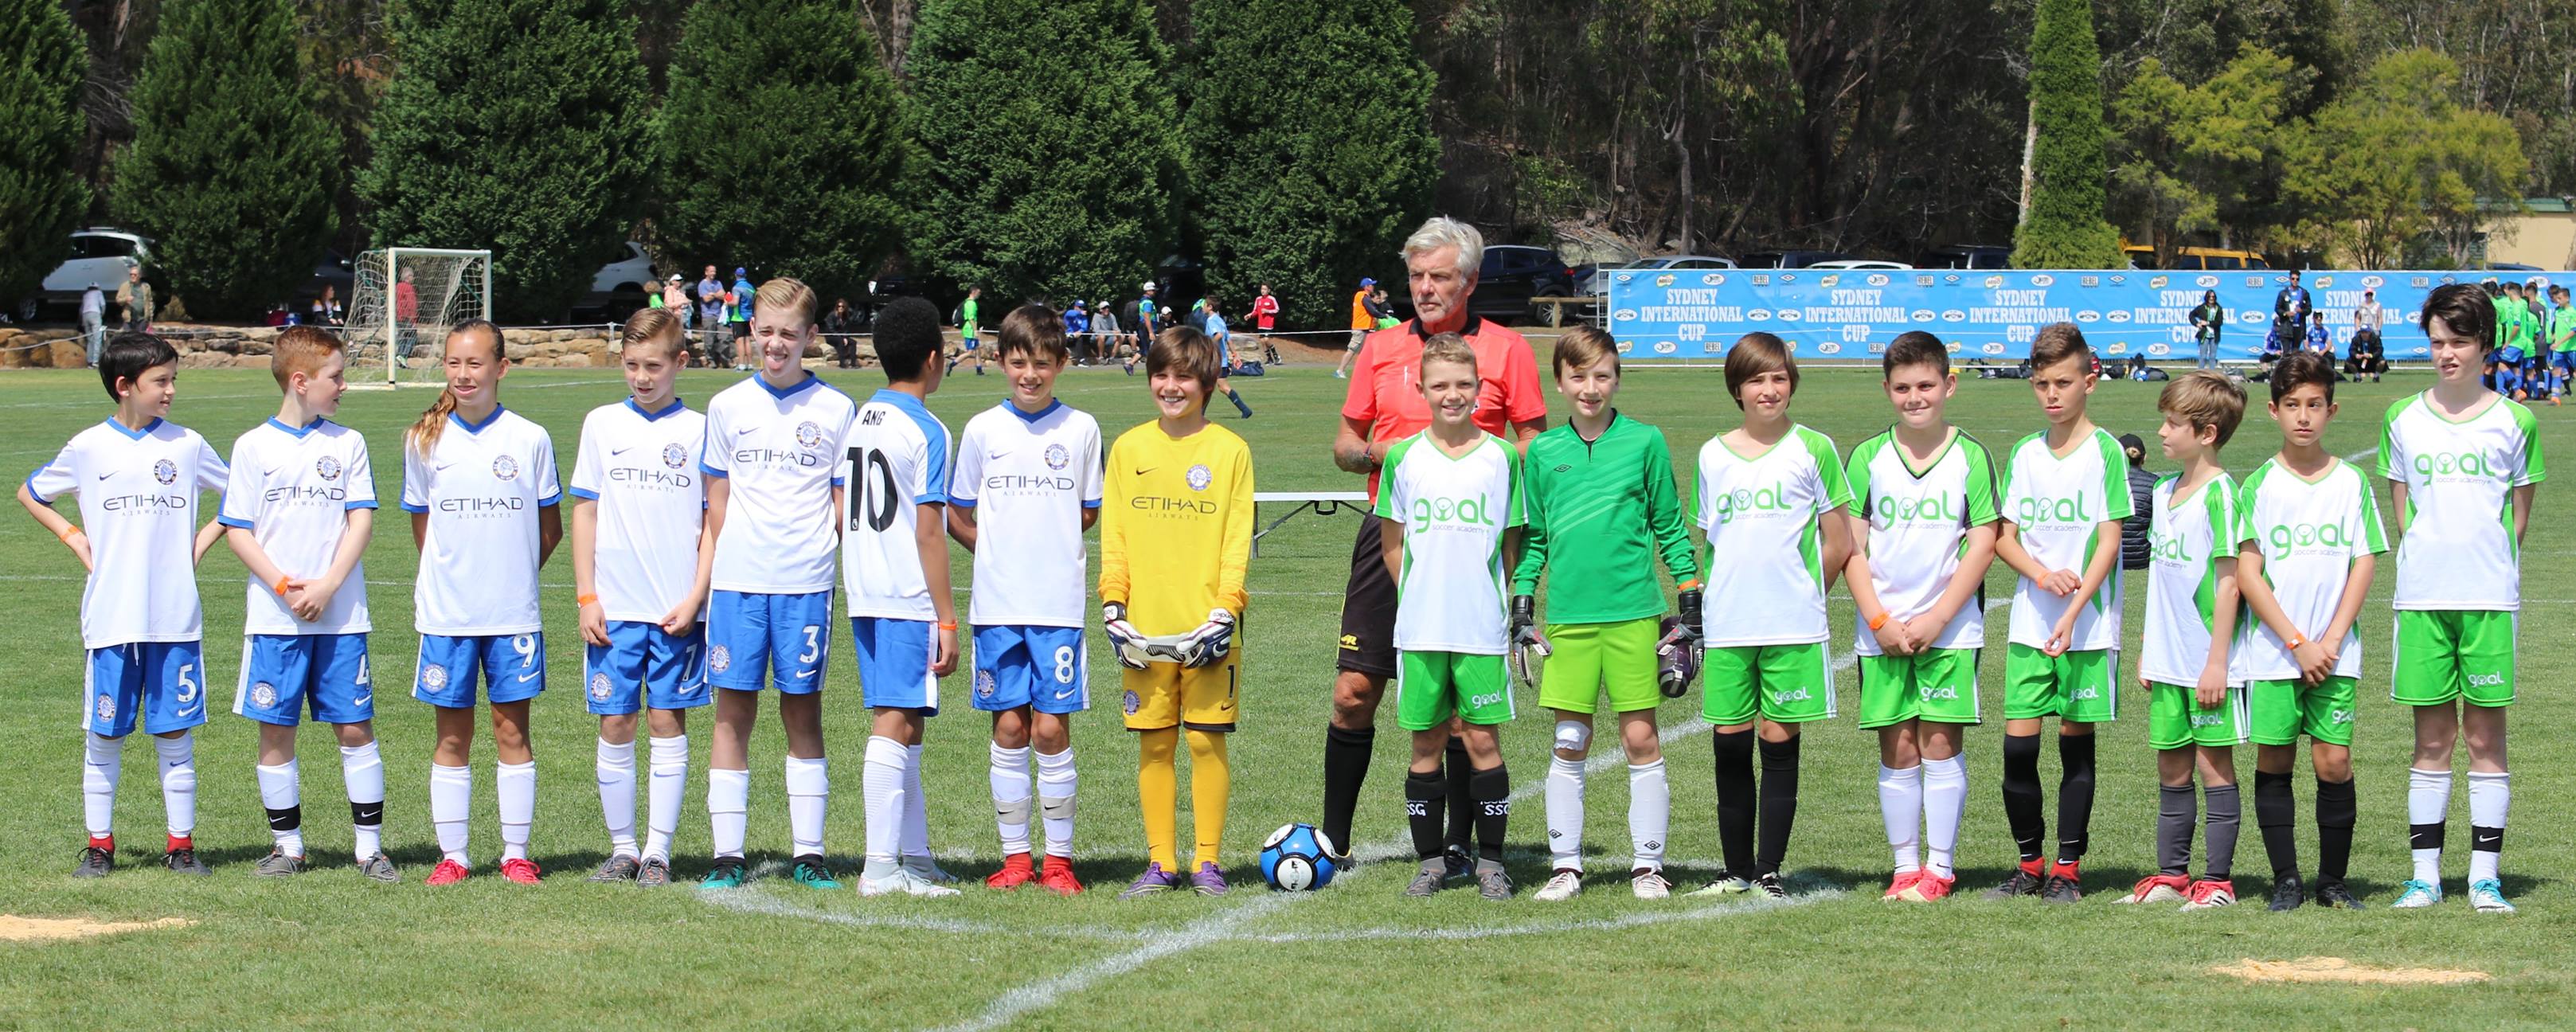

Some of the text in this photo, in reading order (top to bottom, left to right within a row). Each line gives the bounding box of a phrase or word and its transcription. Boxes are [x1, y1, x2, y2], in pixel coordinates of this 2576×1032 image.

[1667, 288, 1718, 305] SYDNEY
[1831, 289, 1882, 306] SYDNEY
[1996, 290, 2046, 307] SYDNEY
[2160, 291, 2205, 307] SYDNE
[1641, 306, 1744, 322] INTERNATIONAL
[1805, 307, 1908, 323] INTERNATIONAL
[1969, 307, 2072, 323] INTERNATIONAL
[2135, 308, 2237, 324] INTERNAAL
[1679, 323, 1706, 341] CUP
[1843, 324, 1870, 342] CUP
[2007, 325, 2035, 342] CUP
[2337, 326, 2357, 344] CU
[862, 409, 885, 425] ANG
[736, 449, 816, 467] ETIHAD
[2414, 448, 2496, 487] goal
[610, 467, 690, 487] ETIHAD
[987, 475, 1074, 491] ETIHAD
[265, 486, 345, 502] ETIHAD
[847, 447, 898, 533] 10
[104, 494, 186, 510] ETIHAD
[440, 497, 523, 511] ETIHAD
[1132, 496, 1217, 514] ETIHAD
[1716, 481, 1792, 524] goal
[1878, 490, 1958, 530] goal
[2019, 490, 2090, 532] goal
[1414, 492, 1494, 534] goal
[513, 633, 536, 668] 9
[799, 625, 820, 663] 3
[682, 643, 698, 682] 7
[1054, 645, 1074, 684] 8
[355, 655, 369, 690] 4
[1227, 664, 1235, 698] 1
[178, 664, 197, 702] 5
[1472, 689, 1503, 710] goal
[1774, 686, 1813, 705] goal
